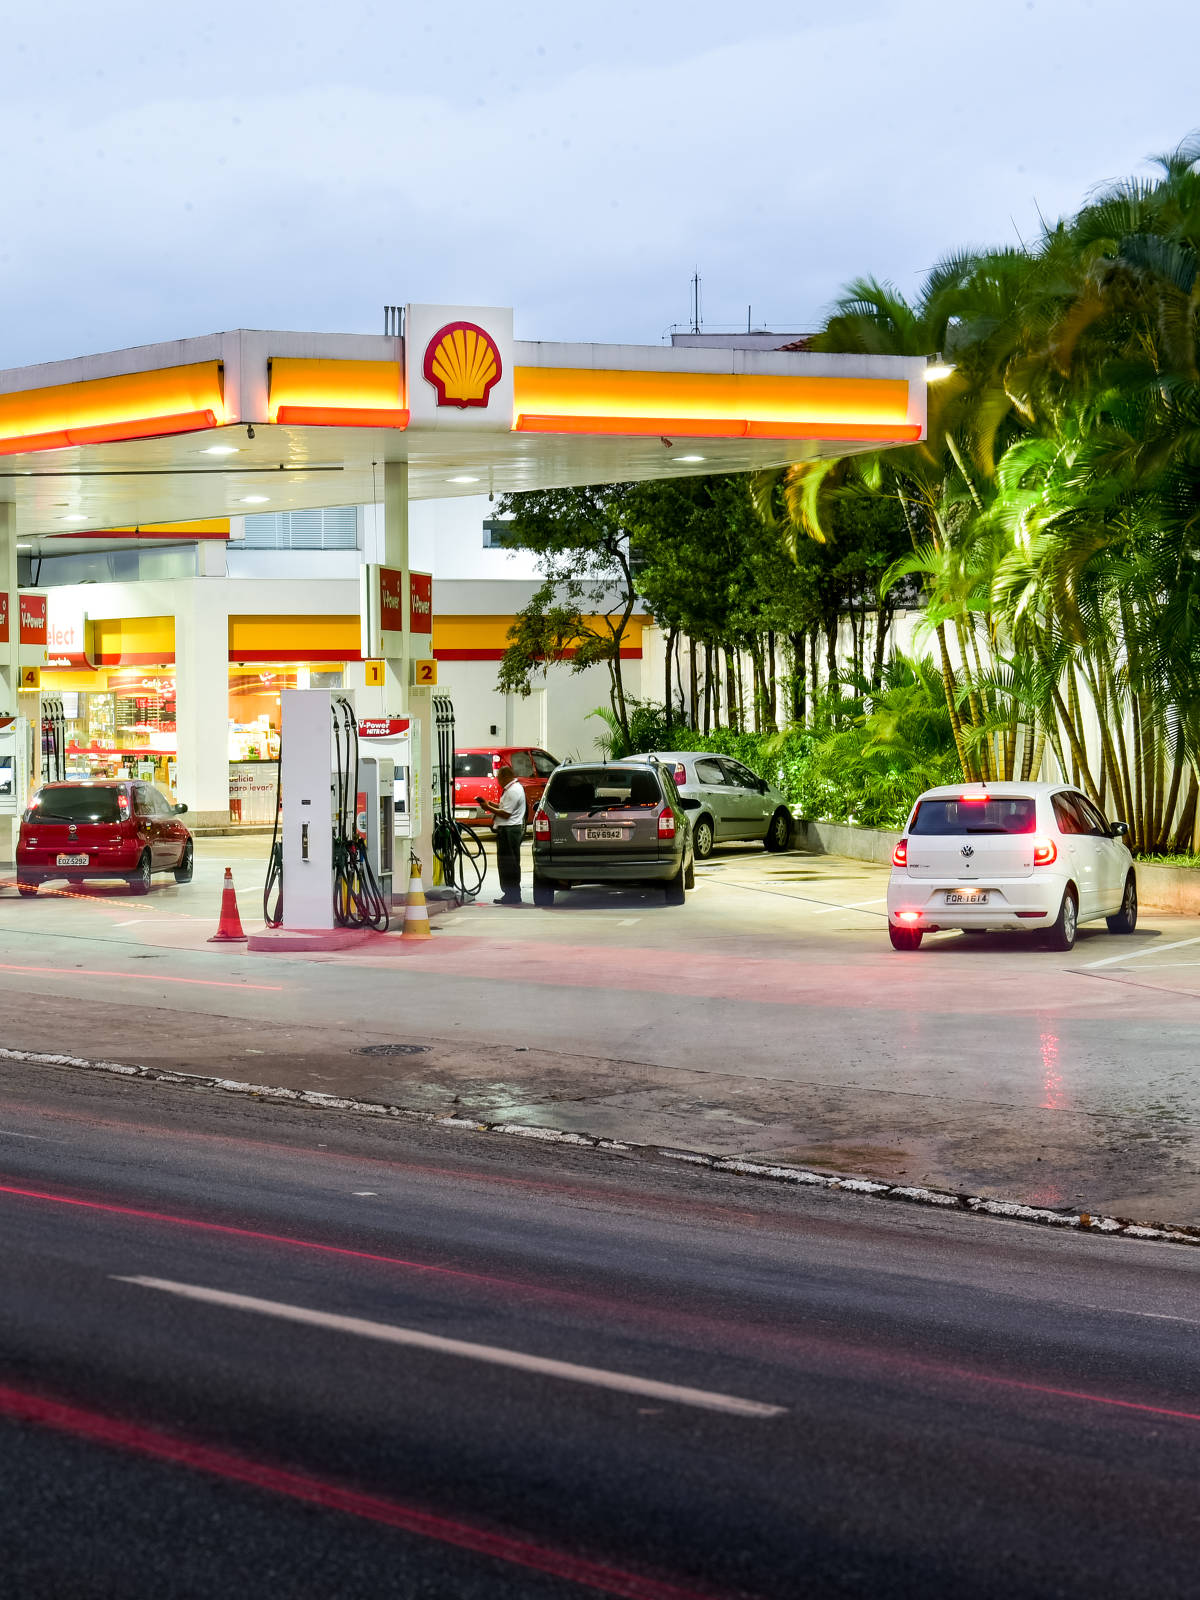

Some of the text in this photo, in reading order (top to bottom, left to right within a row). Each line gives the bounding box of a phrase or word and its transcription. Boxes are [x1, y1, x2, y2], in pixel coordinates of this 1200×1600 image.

[382, 590, 400, 610] V-Power
[412, 594, 430, 614] V-Power
[22, 611, 44, 628] V-Power
[25, 671, 35, 683] 4
[372, 666, 378, 680] 1
[421, 665, 432, 680] 2
[229, 786, 248, 794] para
